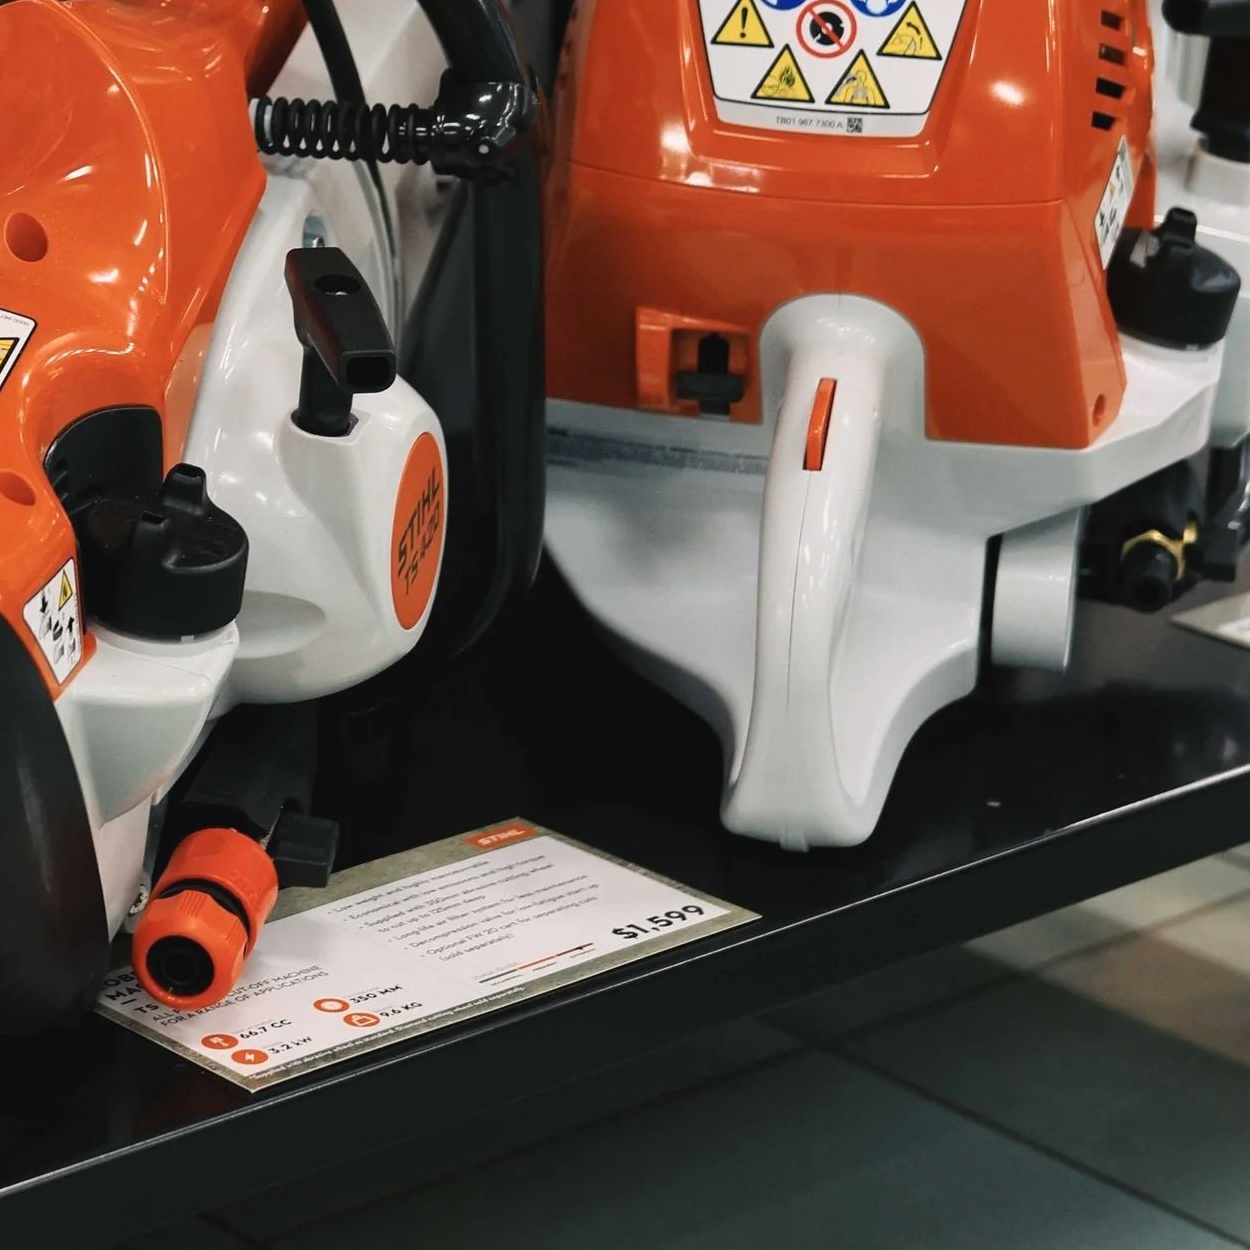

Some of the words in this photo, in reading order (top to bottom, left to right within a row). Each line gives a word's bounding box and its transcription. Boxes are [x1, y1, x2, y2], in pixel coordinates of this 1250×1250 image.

[397, 465, 441, 578] STIHL
[403, 552, 418, 596] TS
[477, 829, 525, 845] STIHL
[612, 905, 705, 939] $1,599
[152, 1012, 174, 1021] ALL
[272, 965, 323, 982] MACHINE
[160, 1015, 187, 1027] FOR
[188, 1011, 197, 1019] A
[195, 1000, 235, 1014] RANGE
[235, 993, 250, 1002] OF
[253, 971, 329, 996] APPLICATIONS
[350, 992, 377, 1003] 350
[379, 984, 403, 995] MM
[134, 1003, 159, 1013] TS
[379, 1008, 401, 1017] 9.6
[400, 1001, 423, 1010] KG
[240, 1026, 267, 1039] 66.7
[270, 1018, 292, 1028] CC
[268, 1043, 292, 1054] 3.2
